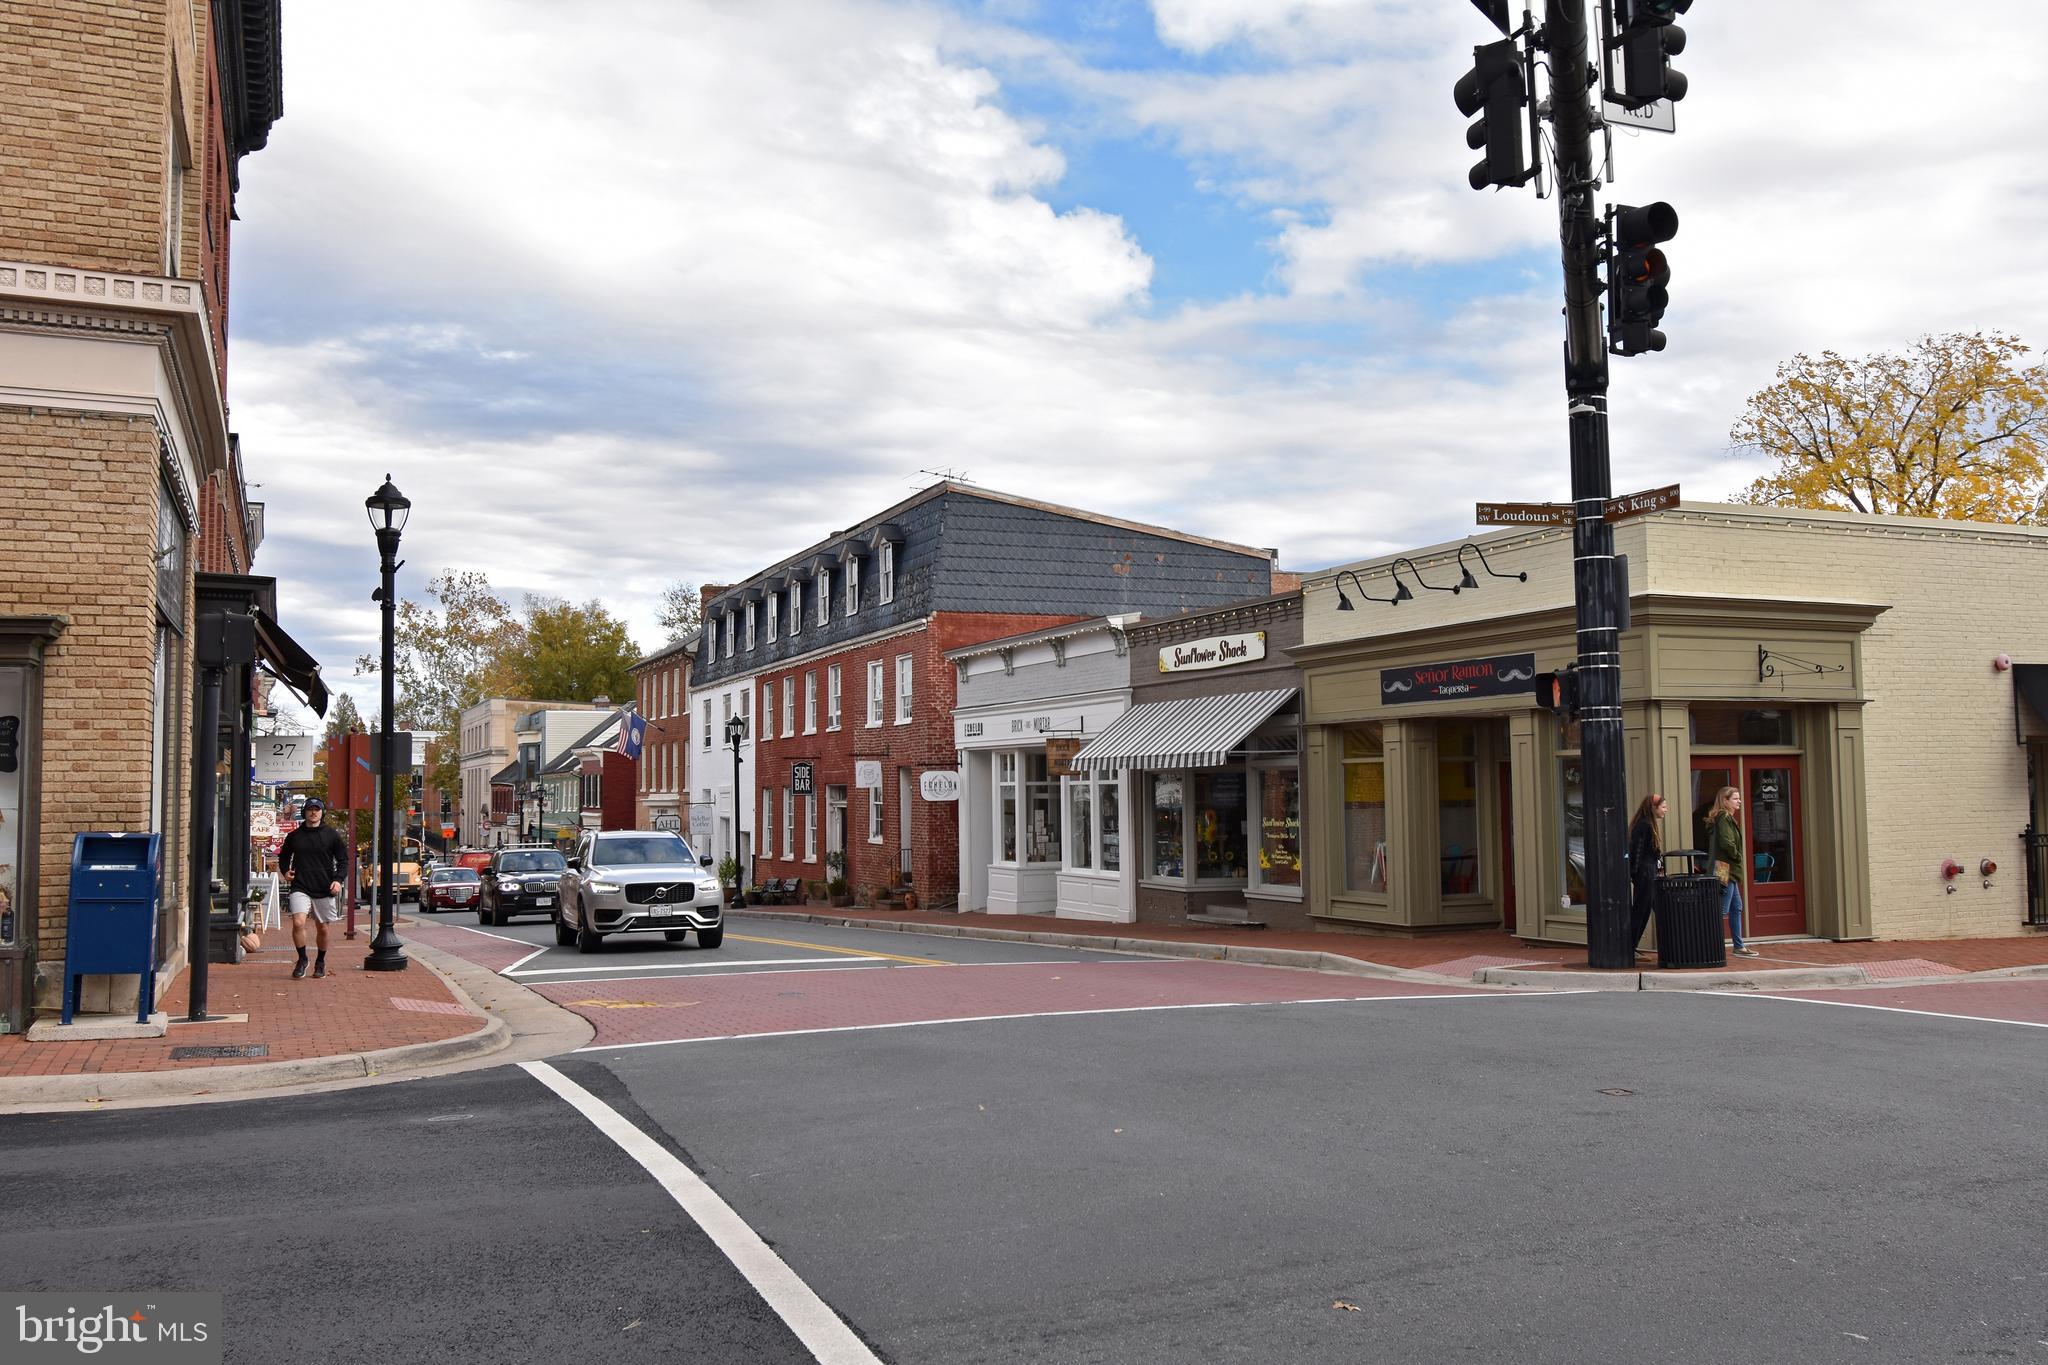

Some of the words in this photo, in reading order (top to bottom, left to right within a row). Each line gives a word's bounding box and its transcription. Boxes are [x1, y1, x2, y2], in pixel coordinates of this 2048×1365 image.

[1605, 504, 1616, 514] 1-99
[1618, 501, 1627, 514] S.
[1631, 496, 1657, 511] King
[1659, 495, 1667, 504] St
[1493, 509, 1550, 522] Loudoun
[1551, 512, 1559, 521] St
[1174, 647, 1217, 668] Sunflower
[1219, 639, 1248, 662] Shack
[1439, 683, 1469, 696] Taqueria
[1011, 719, 1023, 733] BRICK
[273, 743, 297, 760] 27
[794, 766, 811, 779] SIDE
[795, 779, 811, 791] BAR
[658, 820, 679, 828] AHT
